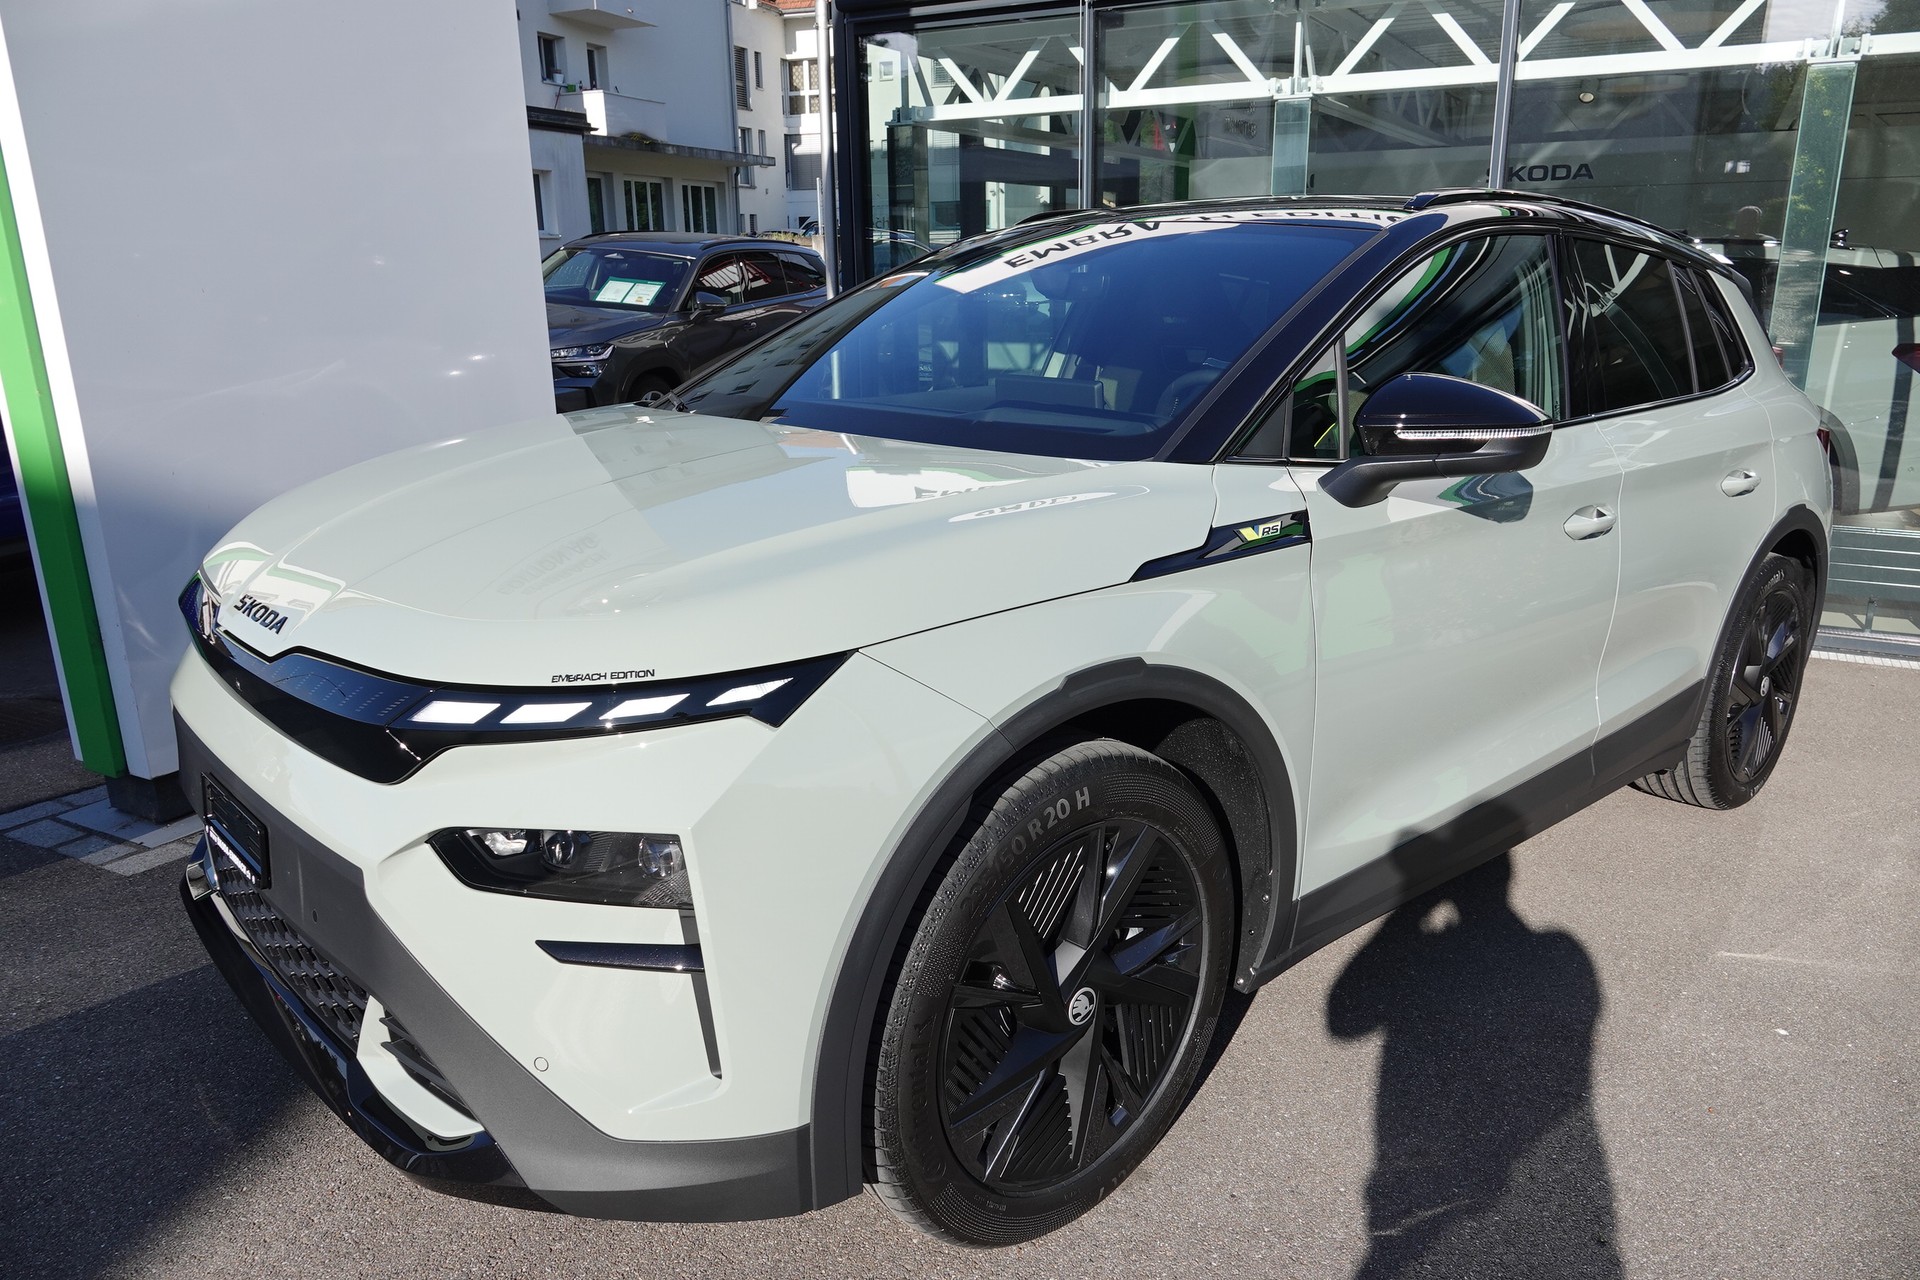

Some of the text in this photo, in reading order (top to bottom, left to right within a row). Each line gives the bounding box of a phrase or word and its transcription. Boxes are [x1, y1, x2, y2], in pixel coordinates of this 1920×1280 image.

[1486, 163, 1594, 183] KODA
[551, 669, 656, 684] EMBRACH EDITION
[1027, 818, 1045, 841] R
[1043, 798, 1071, 830] 20
[1074, 786, 1090, 811] H
